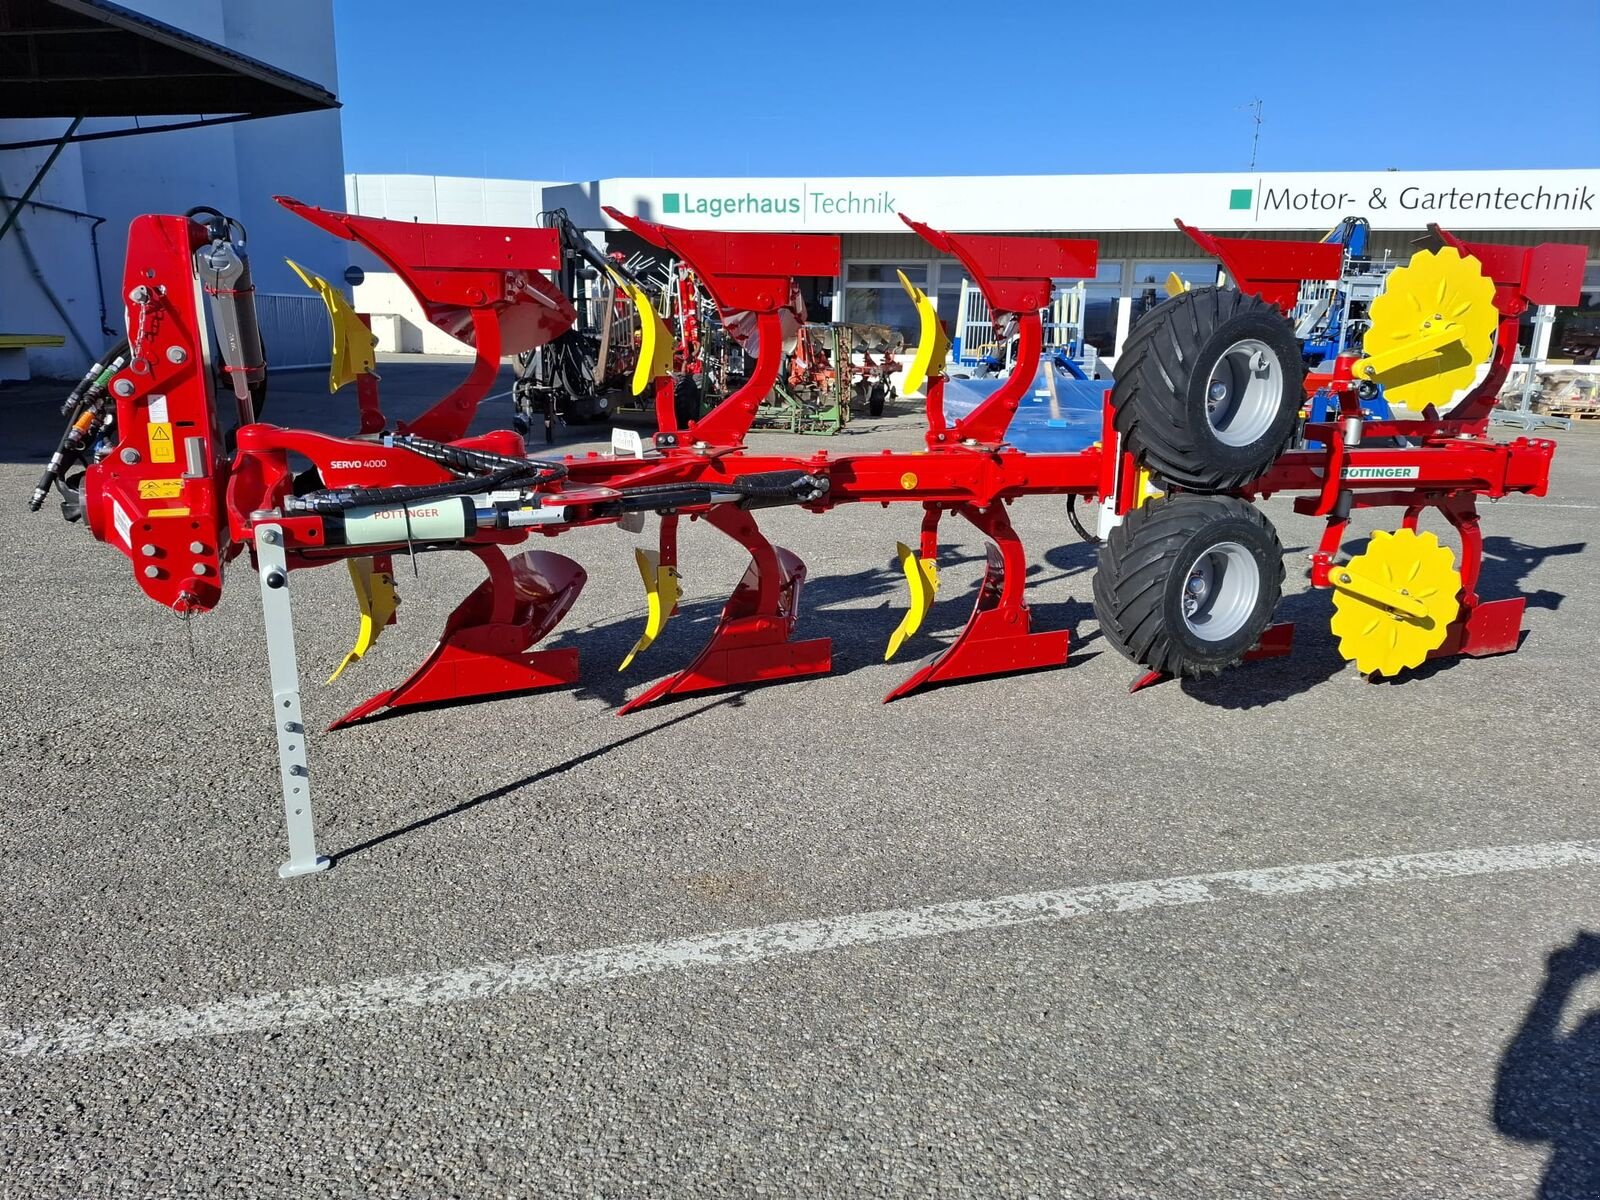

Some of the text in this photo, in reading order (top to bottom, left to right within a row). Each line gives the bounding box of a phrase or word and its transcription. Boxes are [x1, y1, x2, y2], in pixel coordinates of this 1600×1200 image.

[684, 191, 896, 218] Lagerhaus Technik
[1263, 186, 1596, 211] Motor- & Gartentechnik
[330, 459, 387, 469] SERVO 4000
